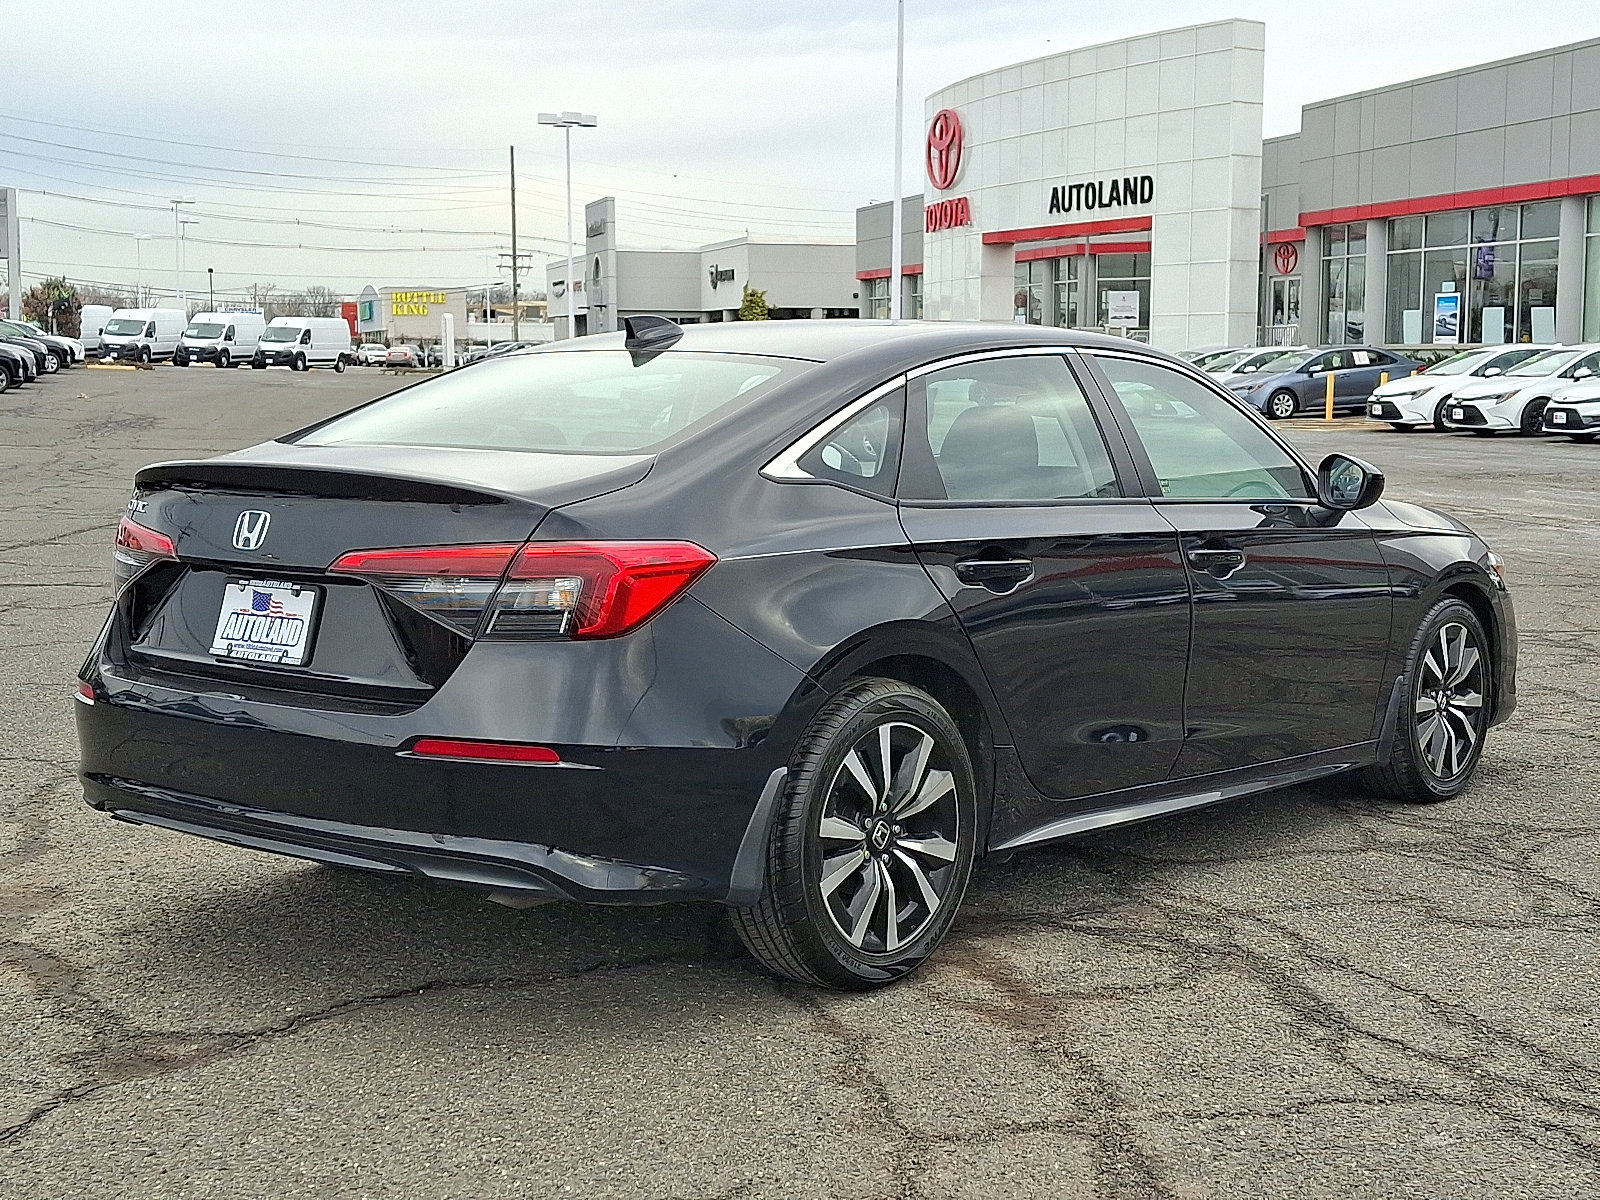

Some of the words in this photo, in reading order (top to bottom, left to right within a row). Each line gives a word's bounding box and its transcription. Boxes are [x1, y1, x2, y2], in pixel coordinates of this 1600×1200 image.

[1048, 175, 1154, 214] AUTOLAND
[924, 196, 971, 233] TOYOTA
[392, 291, 447, 304] BOTTLE
[392, 303, 428, 316] KING
[220, 612, 304, 647] AUTOLAND
[230, 650, 280, 663] AUTOLAND
